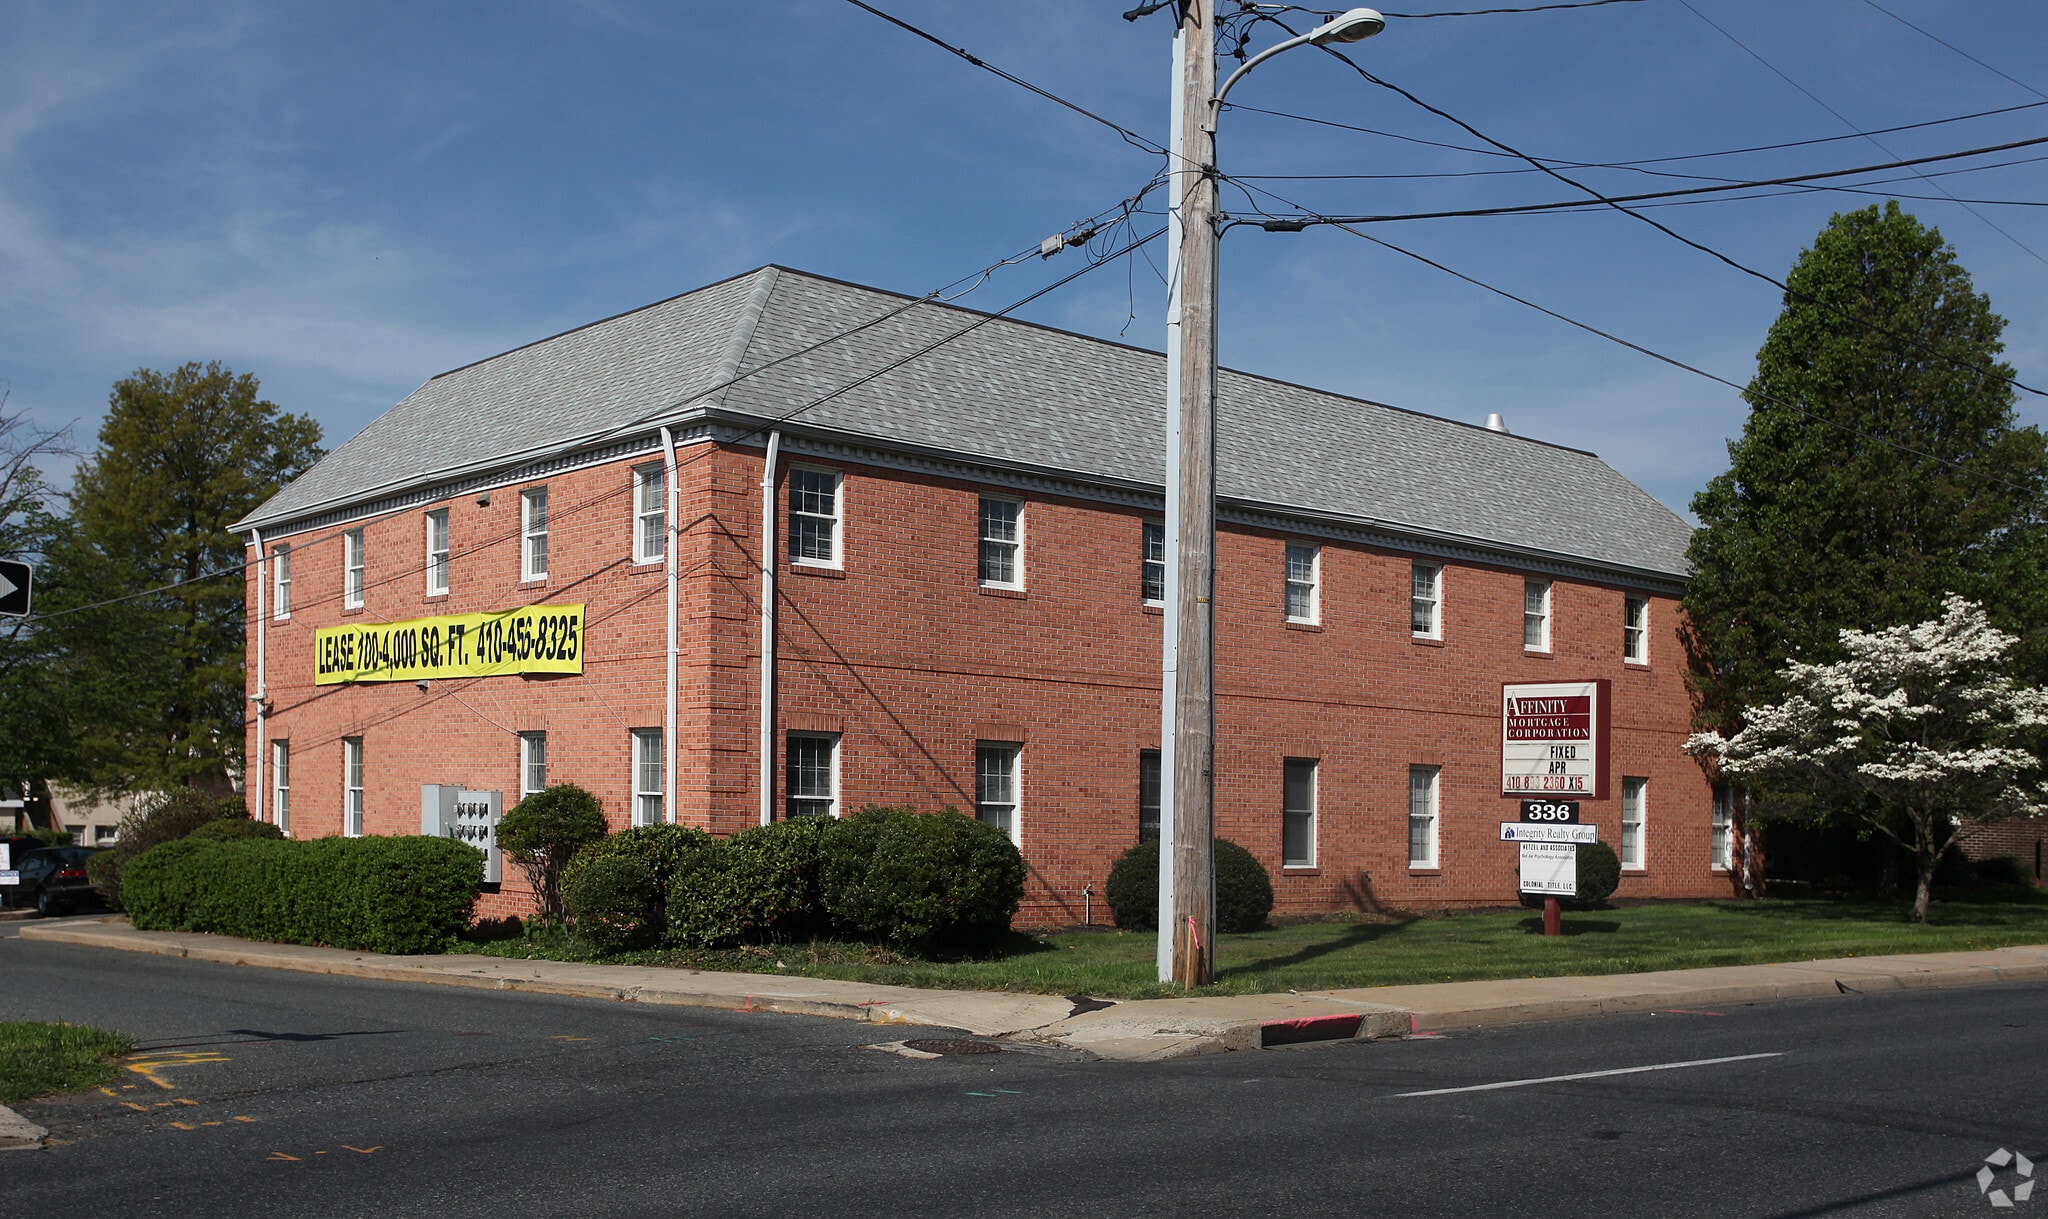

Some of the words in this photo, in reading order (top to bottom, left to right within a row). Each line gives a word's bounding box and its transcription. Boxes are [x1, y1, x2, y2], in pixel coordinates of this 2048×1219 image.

[319, 633, 354, 674] LEASE
[421, 626, 443, 670] SQ.
[448, 624, 468, 665] FT.
[477, 615, 578, 664] 410-456-8325
[1506, 691, 1568, 716] AFFINITY
[1508, 717, 1570, 727] MORTGAGE
[1508, 728, 1589, 738] CORPORATION
[1550, 746, 1576, 759] FIXED
[1548, 761, 1567, 774] APR
[1506, 776, 1521, 789] 410
[1543, 776, 1566, 790] 2360
[1568, 776, 1583, 790] X15
[1528, 804, 1570, 821] 336
[1516, 827, 1546, 841] Integrity
[1547, 828, 1570, 842] Realty
[1571, 829, 1594, 843] Group
[1540, 844, 1549, 852] AND
[1549, 844, 1575, 852] ASSOCIATES
[1523, 880, 1544, 888] COLONIAL
[1547, 881, 1560, 889] TITLE
[1562, 882, 1573, 890] LLC
